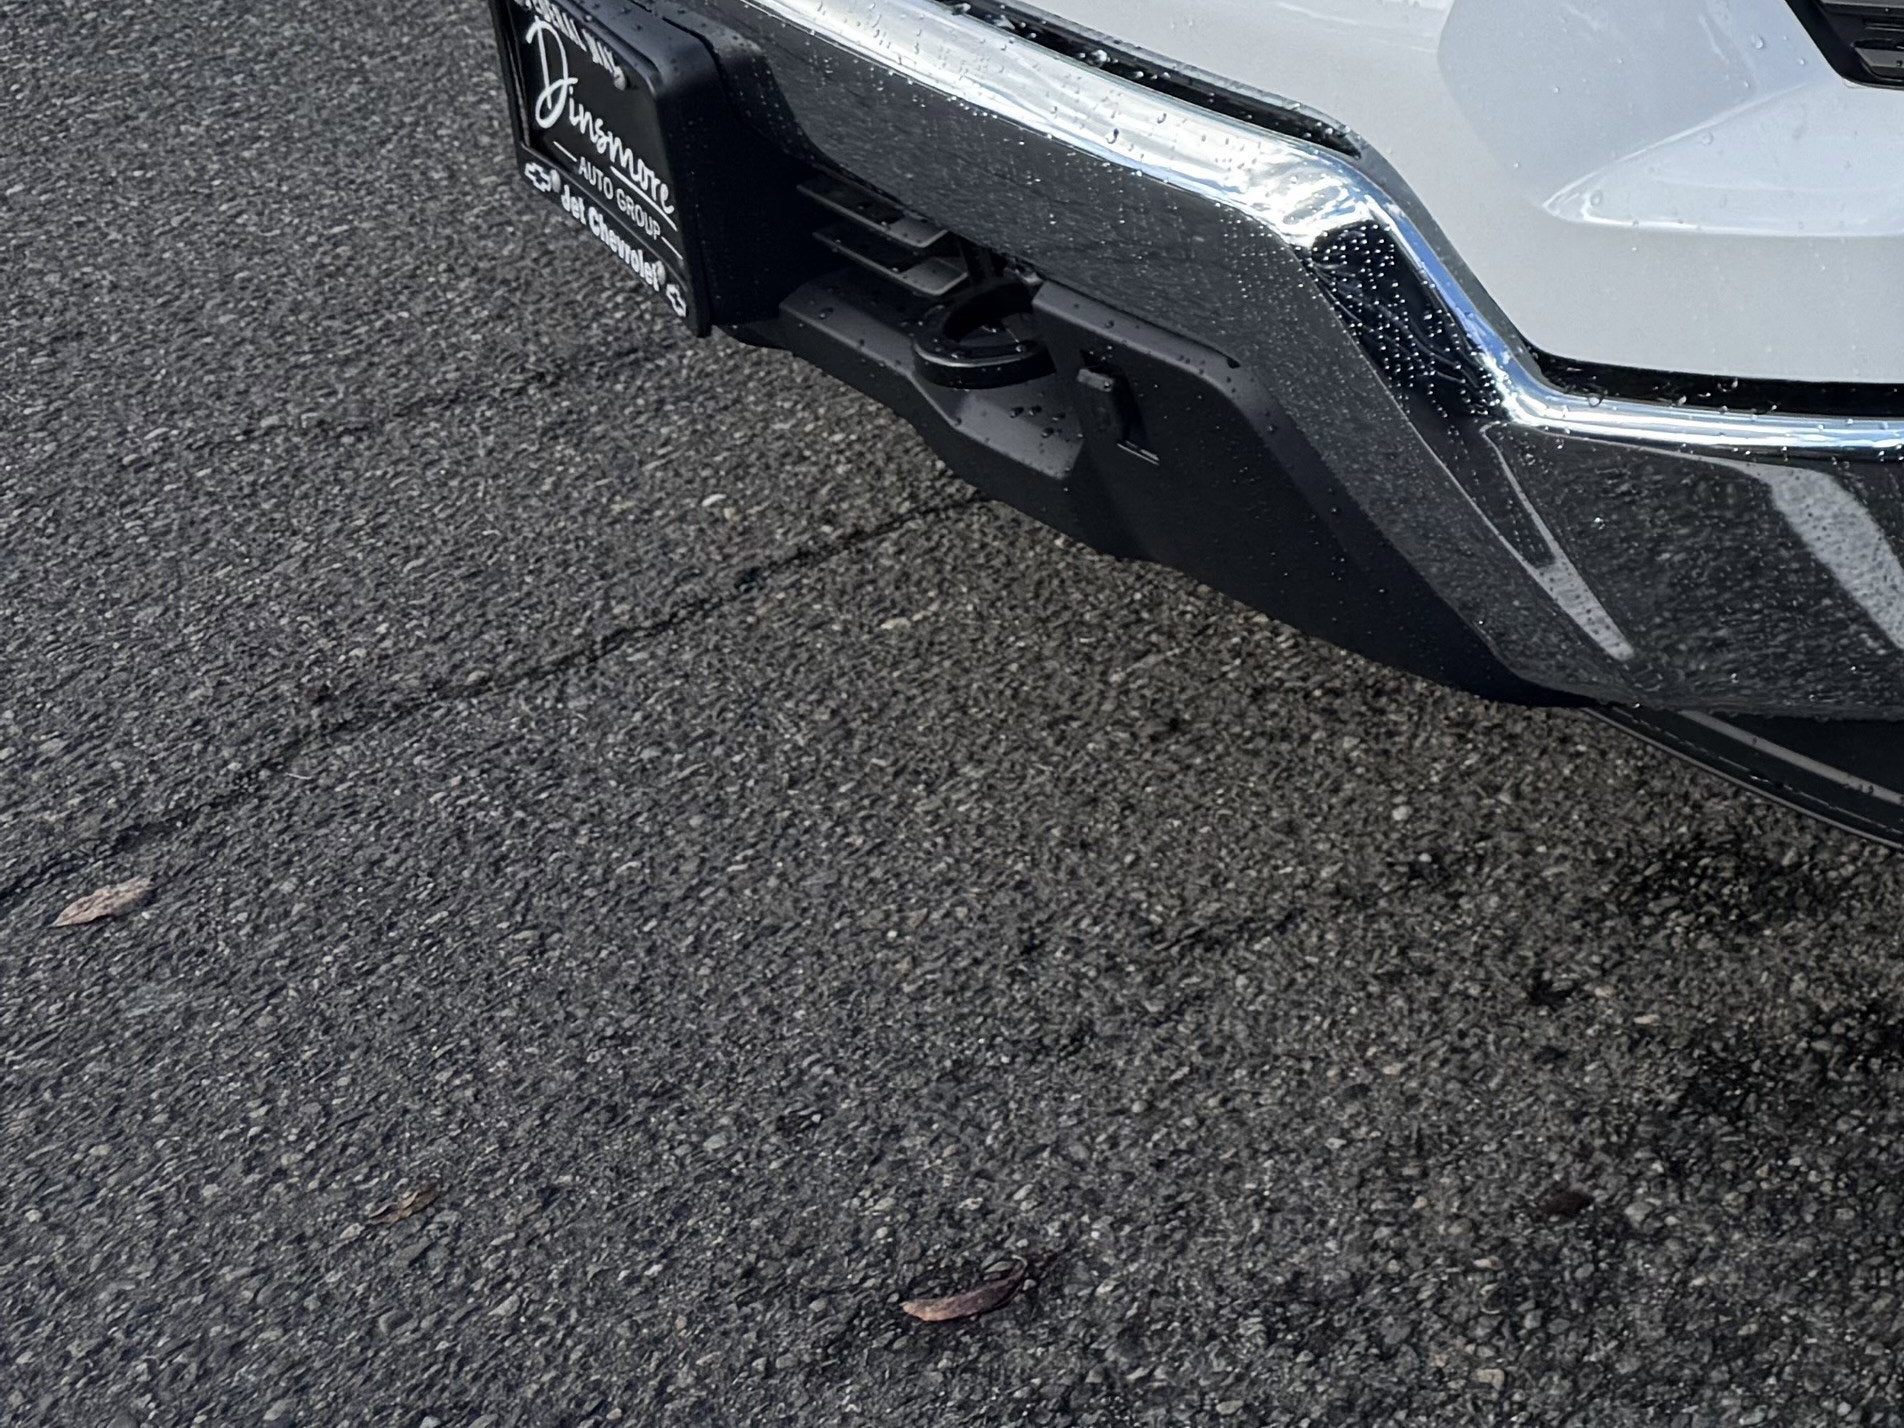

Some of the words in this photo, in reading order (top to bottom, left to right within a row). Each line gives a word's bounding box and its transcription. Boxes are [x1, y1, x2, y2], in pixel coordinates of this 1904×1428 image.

[525, 15, 674, 214] Dinsmore
[561, 184, 586, 225] Jet
[588, 206, 659, 292] Chevrolet
[578, 156, 613, 199] AUTO
[616, 188, 660, 240] GROUP
